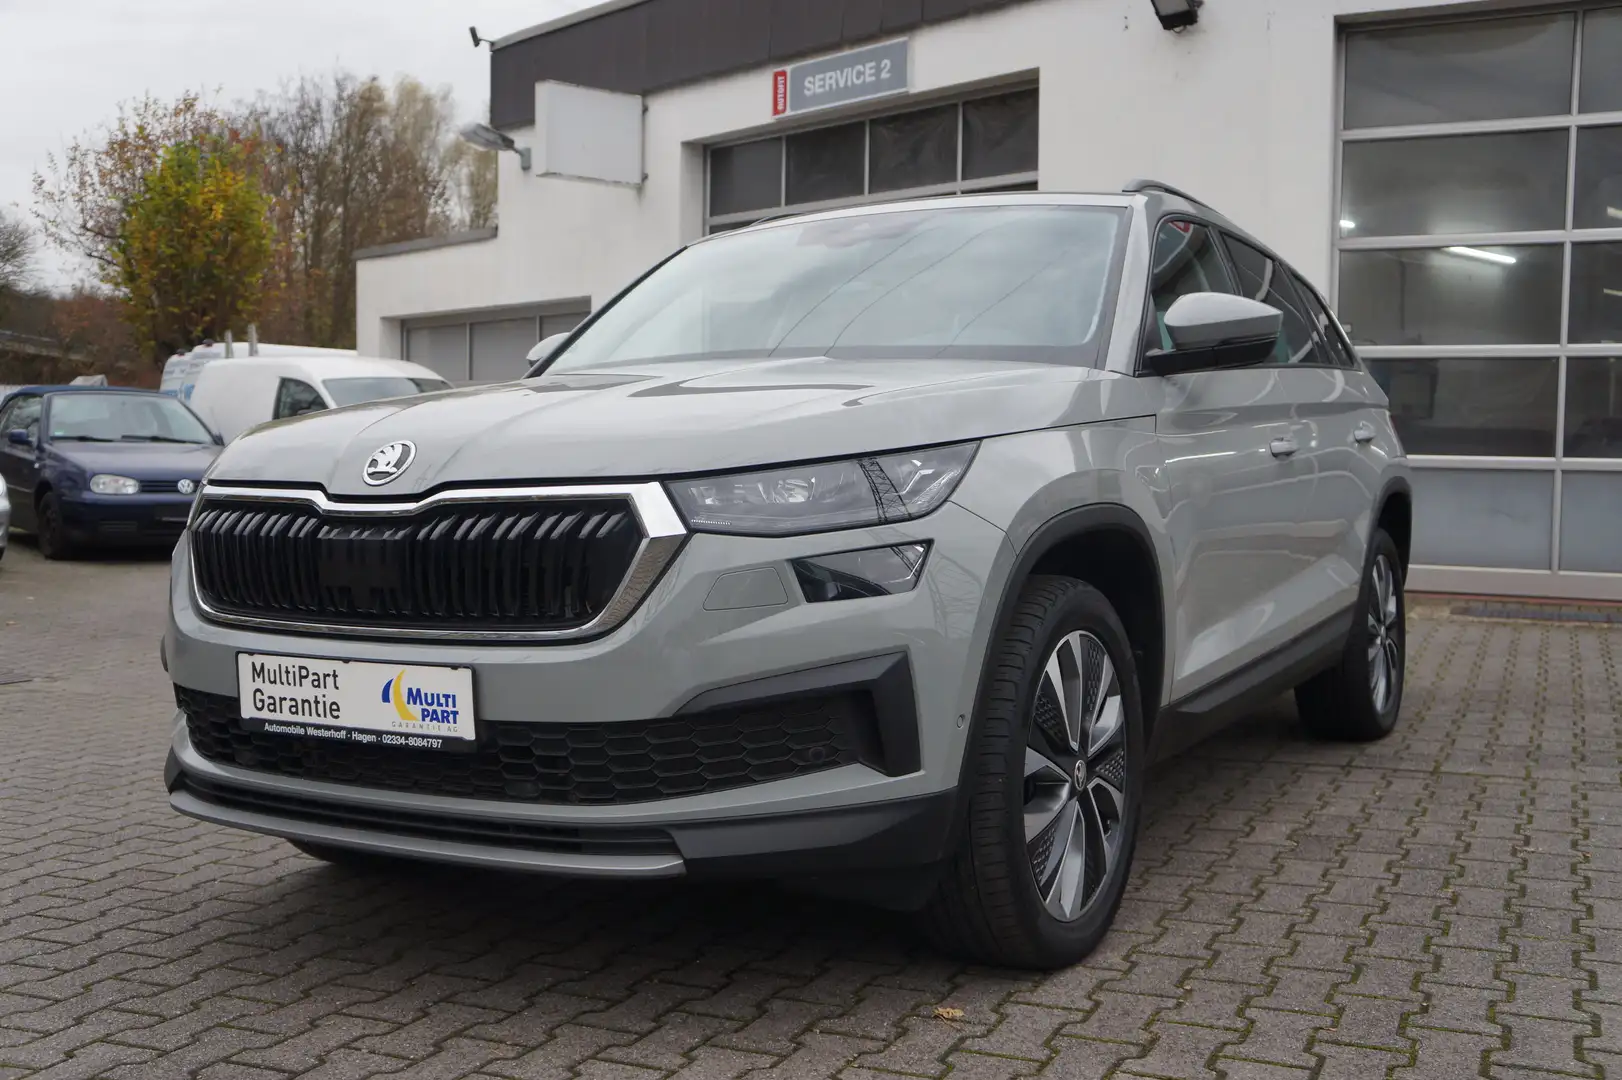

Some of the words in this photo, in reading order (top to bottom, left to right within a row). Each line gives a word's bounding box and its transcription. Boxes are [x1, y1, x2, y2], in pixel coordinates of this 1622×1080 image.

[804, 61, 876, 96] SERVICE
[880, 59, 891, 79] 2
[251, 661, 340, 691] MultiPart
[253, 688, 341, 720] Garantie
[406, 687, 457, 709] MULTI
[391, 721, 441, 732] GARANTIE
[420, 707, 459, 724] PART
[264, 722, 305, 735] Automobile
[306, 726, 346, 740] Westerhoff
[351, 730, 377, 743] Hagen
